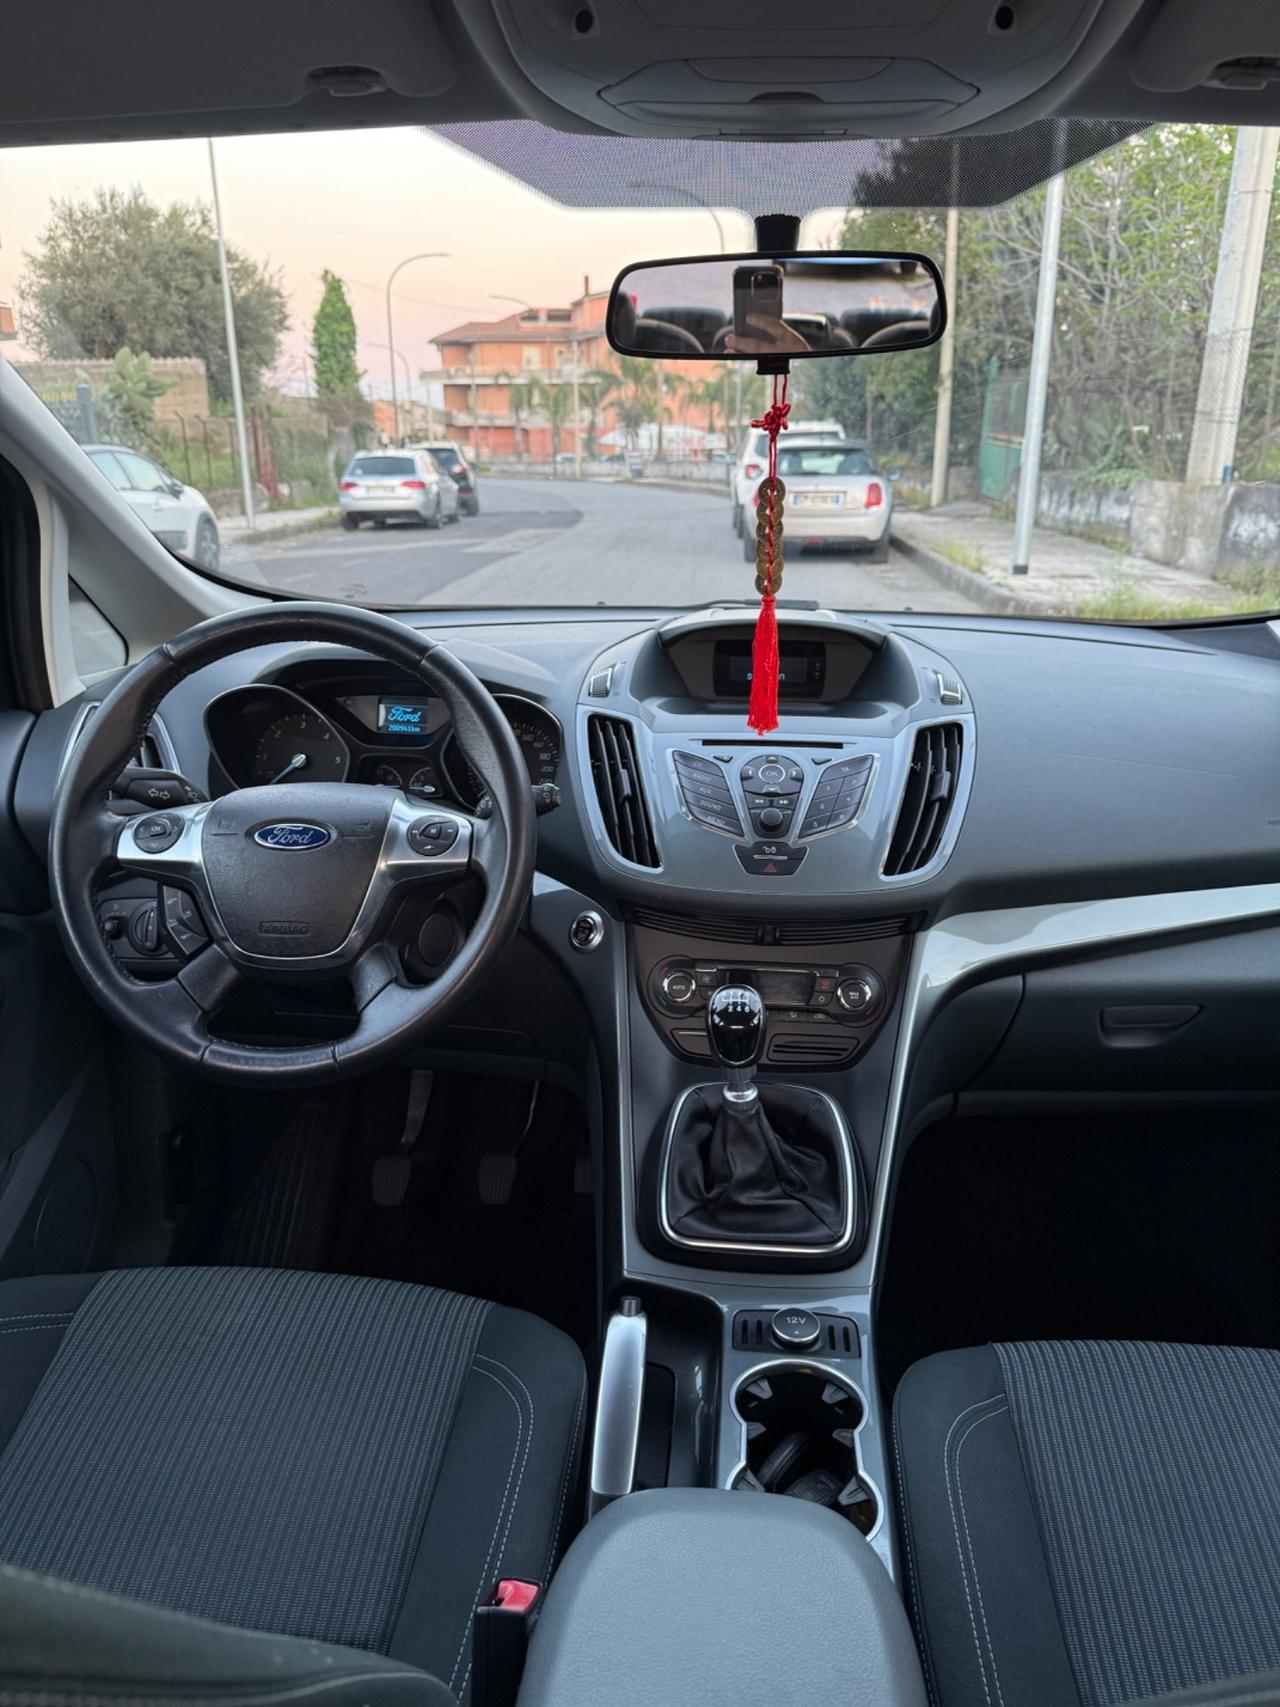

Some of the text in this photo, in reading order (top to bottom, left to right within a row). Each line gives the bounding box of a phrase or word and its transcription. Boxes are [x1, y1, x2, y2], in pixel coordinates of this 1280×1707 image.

[388, 706, 421, 722] Ford
[267, 825, 314, 844] Ford
[785, 1316, 806, 1325] 12V
